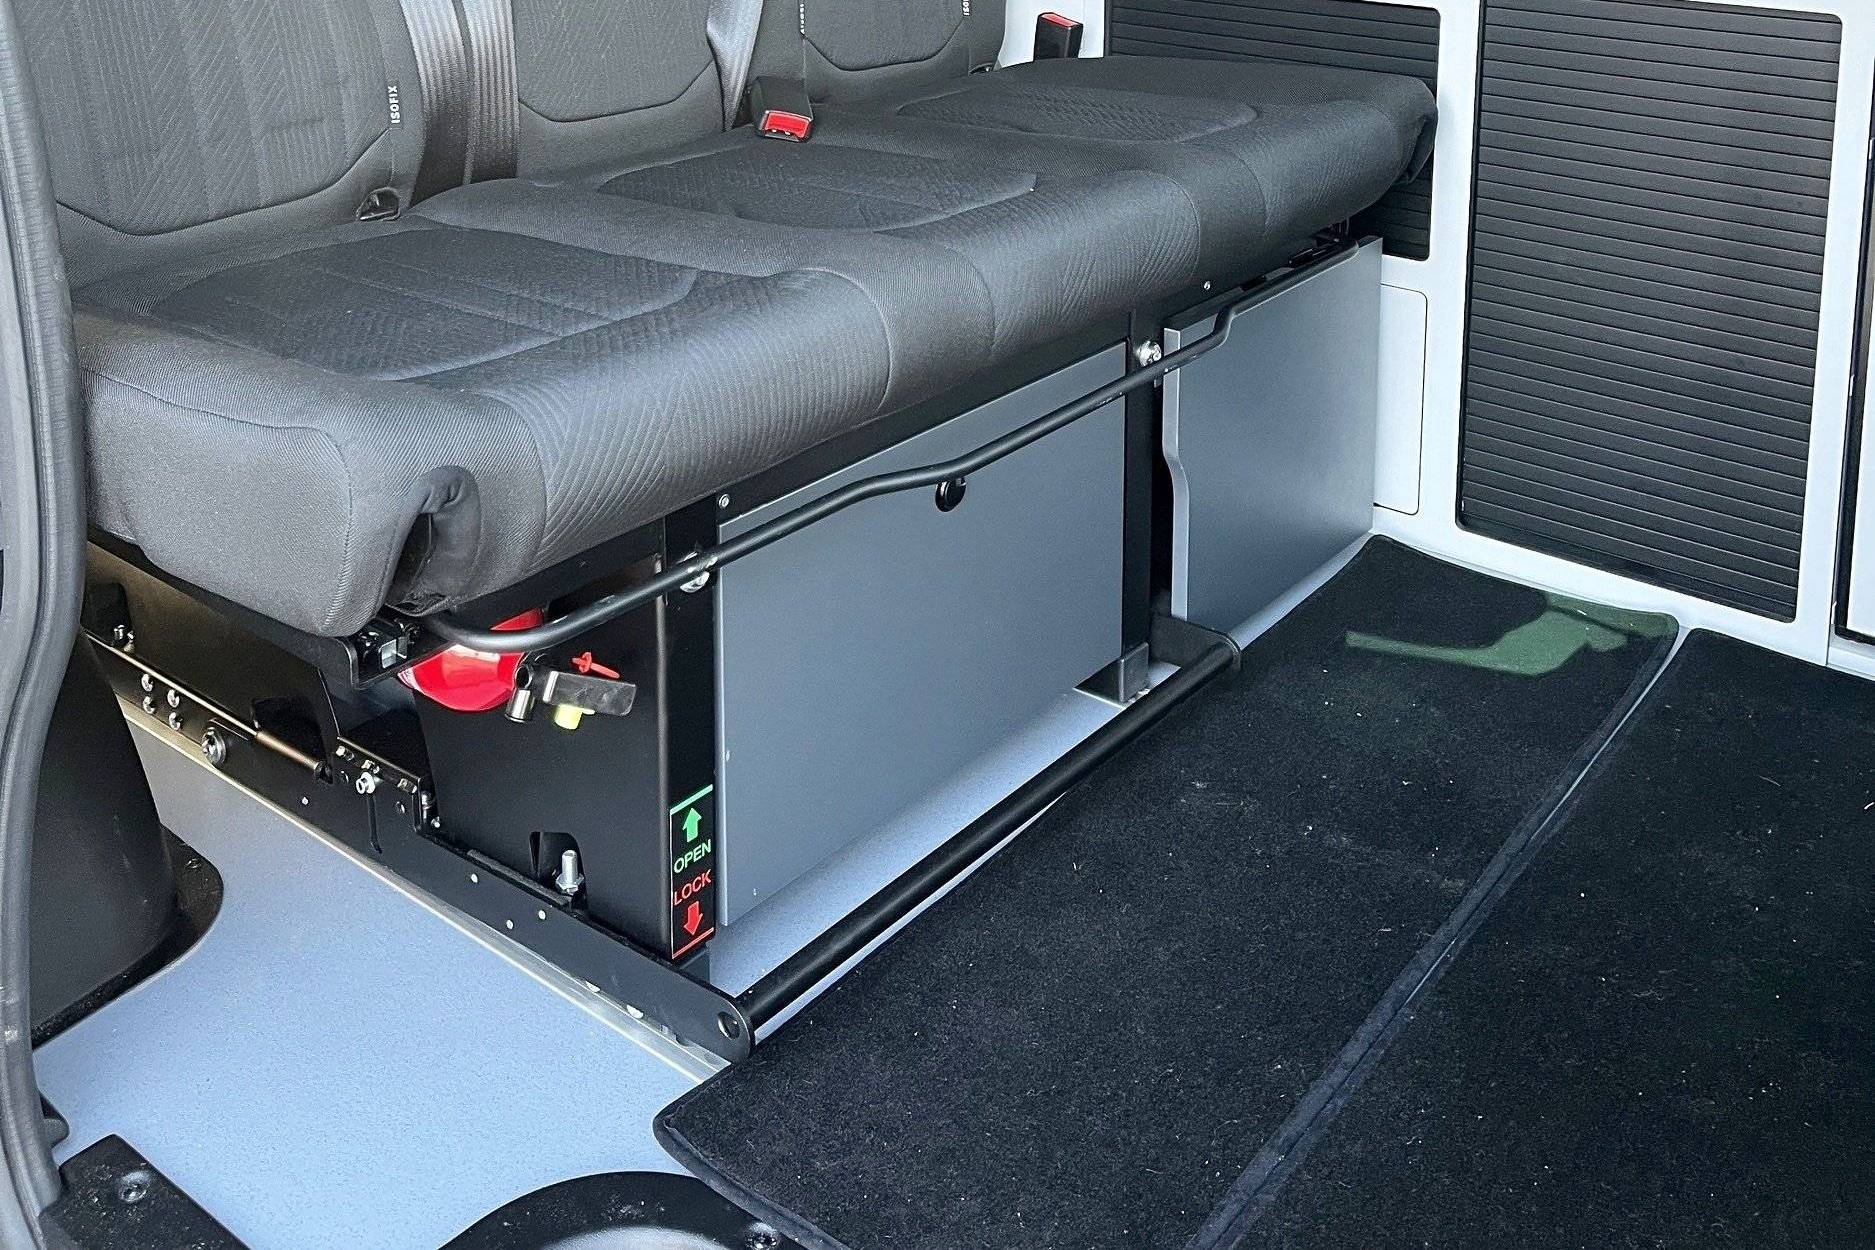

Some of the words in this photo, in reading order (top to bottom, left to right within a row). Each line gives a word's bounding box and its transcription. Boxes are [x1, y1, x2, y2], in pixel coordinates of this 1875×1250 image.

[387, 85, 400, 124] ISOFIX
[673, 838, 712, 873] OPEN
[673, 868, 712, 906] LOCK
